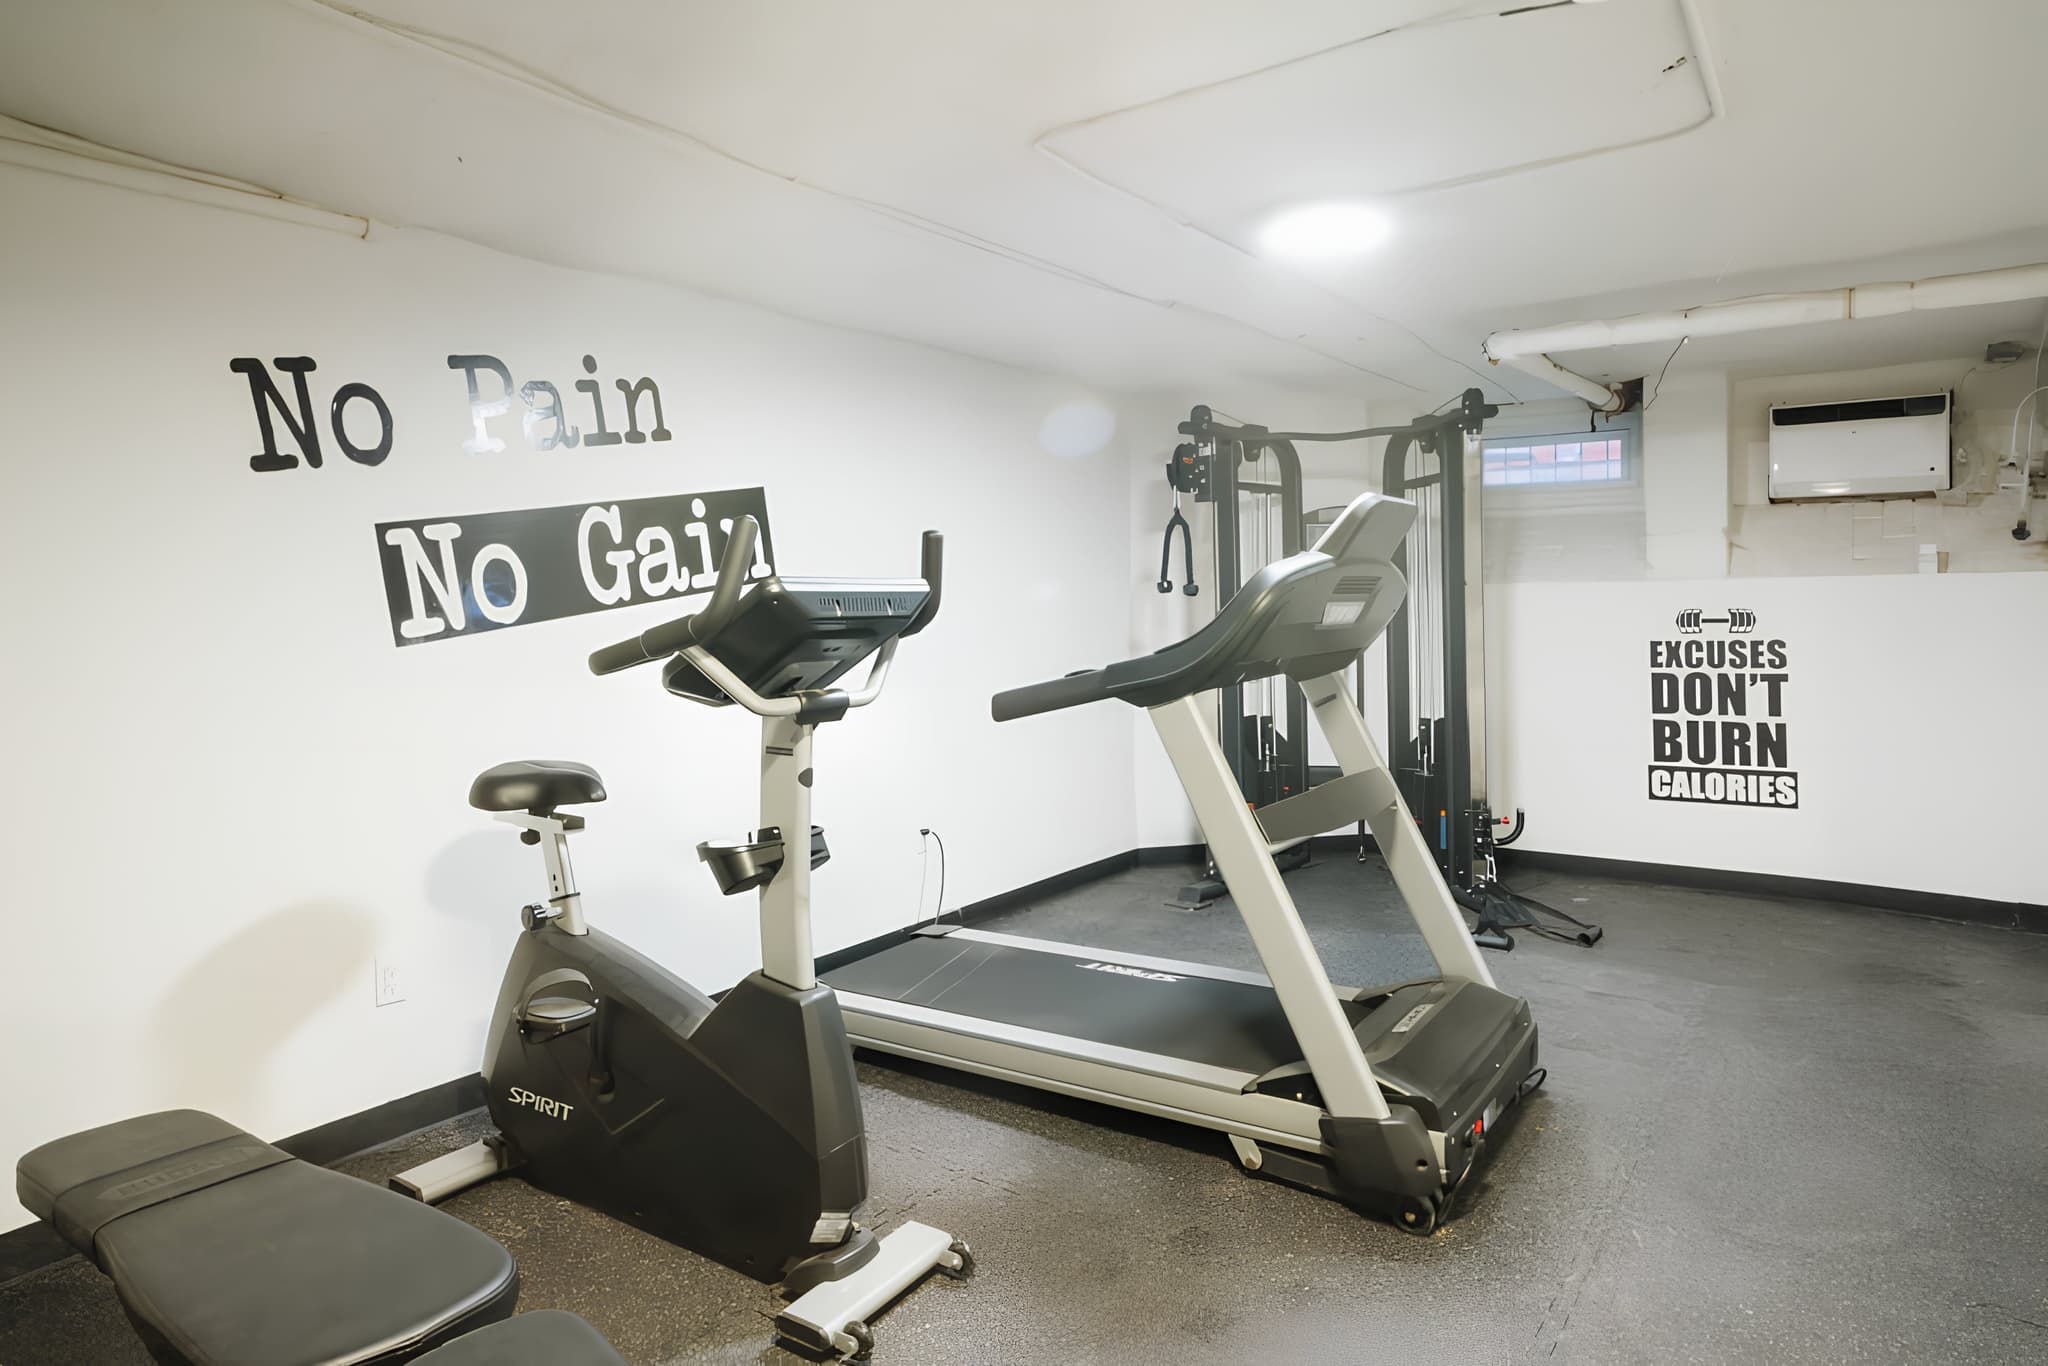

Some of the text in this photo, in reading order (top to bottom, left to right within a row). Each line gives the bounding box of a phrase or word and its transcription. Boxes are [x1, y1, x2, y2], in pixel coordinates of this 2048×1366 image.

[230, 354, 672, 472] No Pain
[385, 522, 528, 640] No
[1650, 639, 1787, 669] EXCUSES
[1651, 672, 1788, 717] DON'T
[1653, 719, 1787, 768] BURN
[1651, 769, 1796, 805] CALORIES
[508, 1087, 574, 1121] SPIRIT
